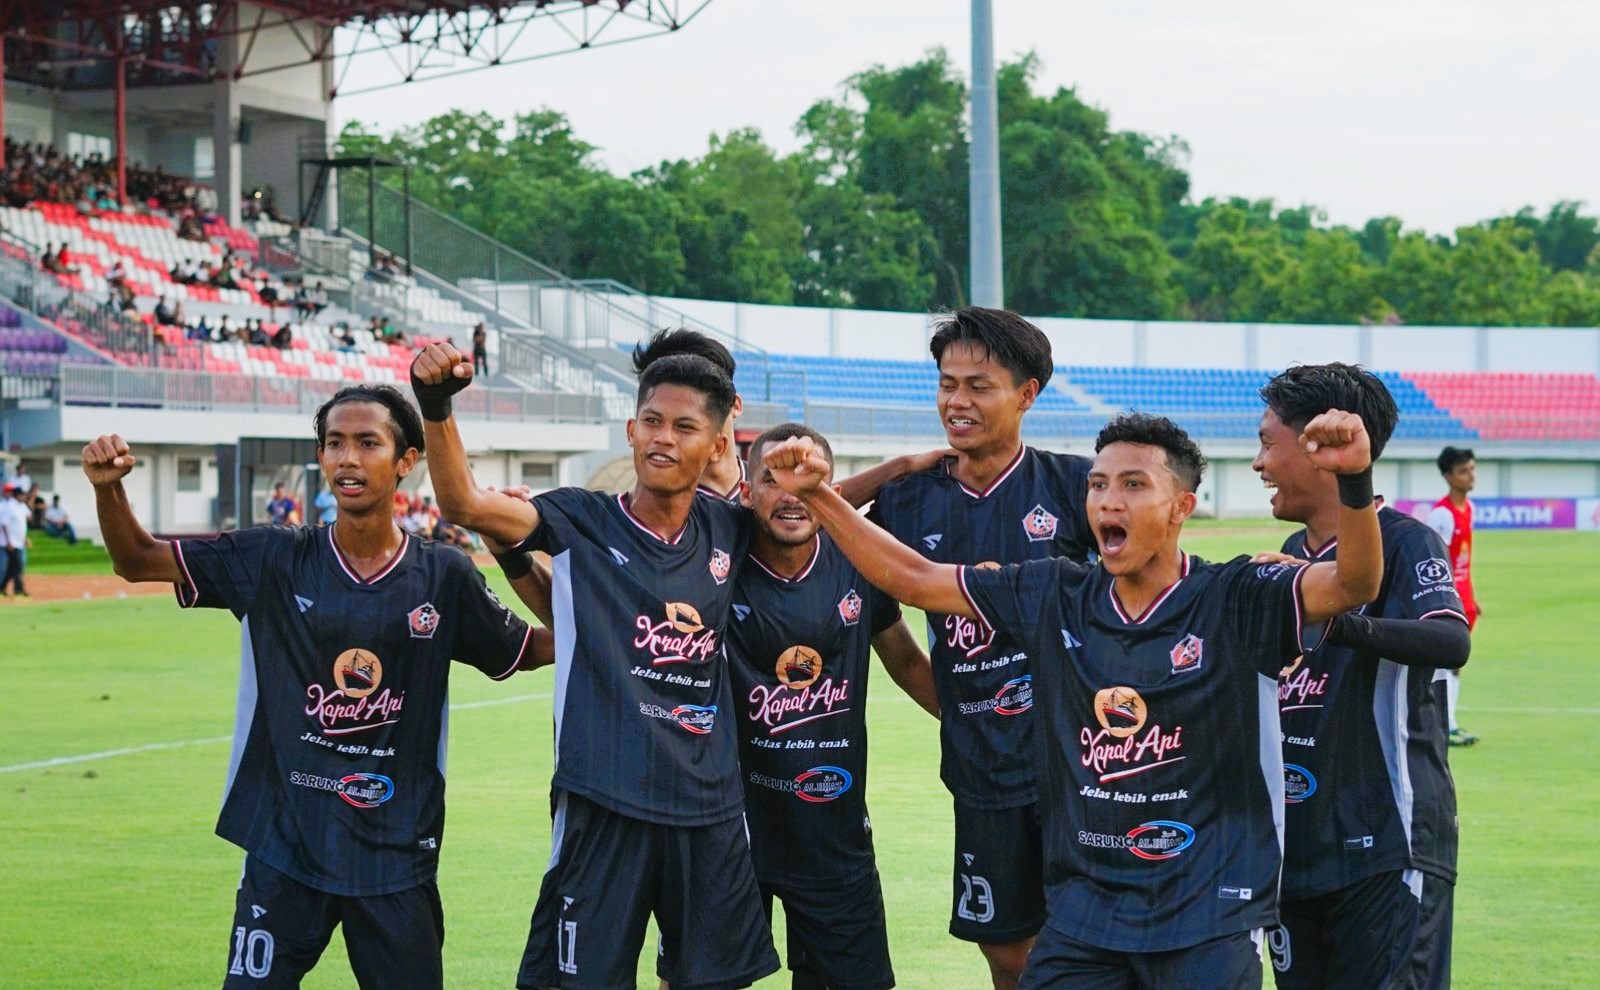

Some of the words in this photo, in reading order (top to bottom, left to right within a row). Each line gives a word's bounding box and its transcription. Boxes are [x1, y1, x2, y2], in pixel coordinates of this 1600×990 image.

[952, 663, 977, 673] Jelas
[981, 656, 1010, 671] lebih
[631, 666, 663, 680] Jelas
[664, 673, 693, 686] lebih
[1285, 668, 1329, 704] Api
[305, 684, 368, 727] Kapal
[364, 688, 404, 721] Api
[749, 684, 811, 725] Kapal
[808, 678, 849, 712] Api
[958, 698, 999, 715] SARUNG
[300, 732, 334, 748] Jelas
[336, 744, 370, 754] lebih
[750, 737, 781, 749] Jelas
[785, 739, 815, 749] lebih
[818, 738, 849, 748] enak
[1080, 726, 1132, 774] Kapal
[1134, 725, 1183, 761] Api
[1287, 736, 1316, 747] enak
[290, 771, 344, 792] SARUNG
[749, 771, 801, 792] SARUNG
[1080, 785, 1111, 800] Jelas
[1113, 791, 1147, 803] lebih
[1151, 789, 1189, 801] enak
[1078, 830, 1135, 849] SARUNG
[958, 873, 995, 923] 23
[229, 926, 275, 978] 10
